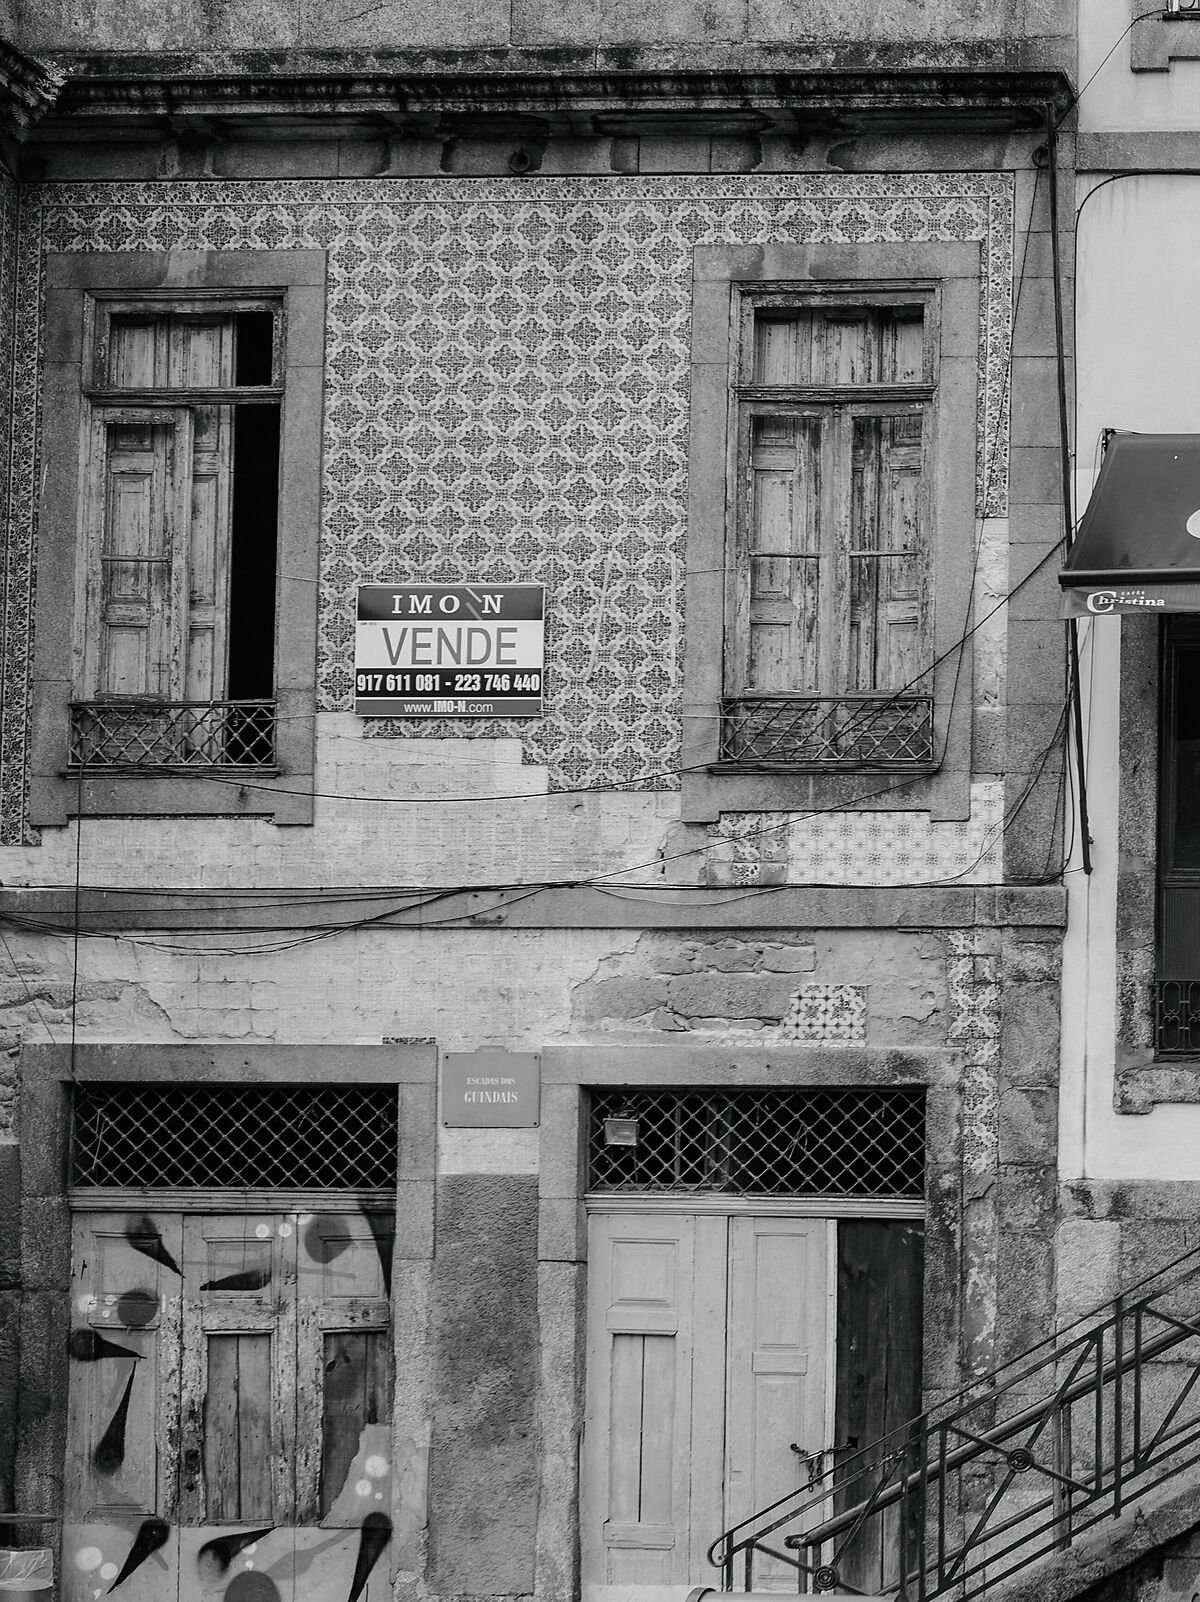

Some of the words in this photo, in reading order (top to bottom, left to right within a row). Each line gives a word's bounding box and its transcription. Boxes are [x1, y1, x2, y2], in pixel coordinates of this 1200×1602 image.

[1086, 590, 1166, 613] Christina
[381, 627, 518, 666] VENDE
[357, 674, 383, 692] 917
[386, 674, 411, 692] 611
[415, 674, 440, 692] 081
[454, 674, 482, 692] 223
[484, 674, 511, 692] 746
[513, 674, 540, 692] 440
[404, 700, 494, 713] www.IMO-N.com
[466, 1077, 499, 1086] ESCADAS
[500, 1077, 517, 1086] DOS
[464, 1091, 518, 1104] GUINDAIS
